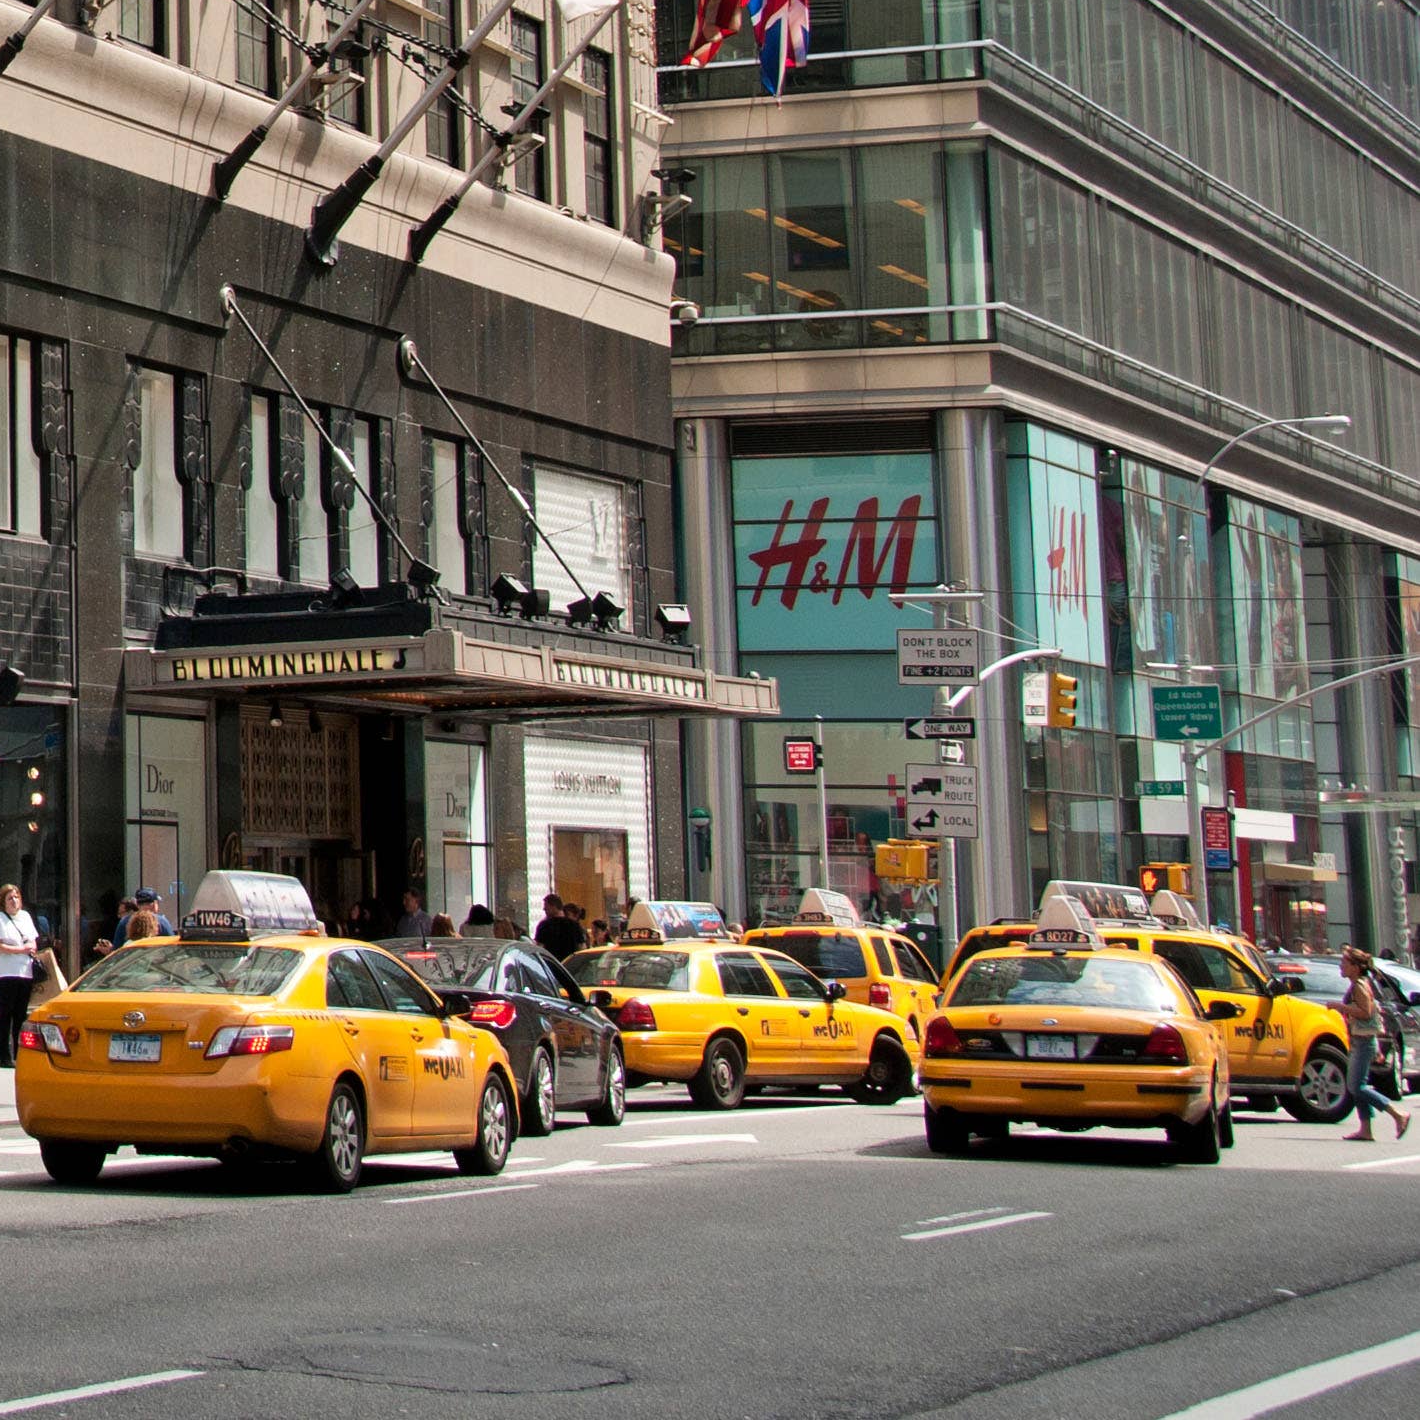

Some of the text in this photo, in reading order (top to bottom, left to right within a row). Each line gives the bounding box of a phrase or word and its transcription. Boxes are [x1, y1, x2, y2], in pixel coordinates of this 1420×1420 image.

[748, 494, 921, 611] H&M
[1047, 504, 1088, 624] H&M
[903, 637, 973, 647] DON'T BLOCK
[916, 649, 960, 658] THE BOX
[923, 724, 968, 733] ONE WAY
[145, 763, 175, 795] Dior
[945, 775, 974, 786] TRUCK
[1158, 783, 1173, 794] 59
[944, 791, 974, 801] ROUTE
[943, 816, 974, 827] LOCAL
[198, 912, 231, 926] 1W46
[1046, 931, 1074, 942] 8D27
